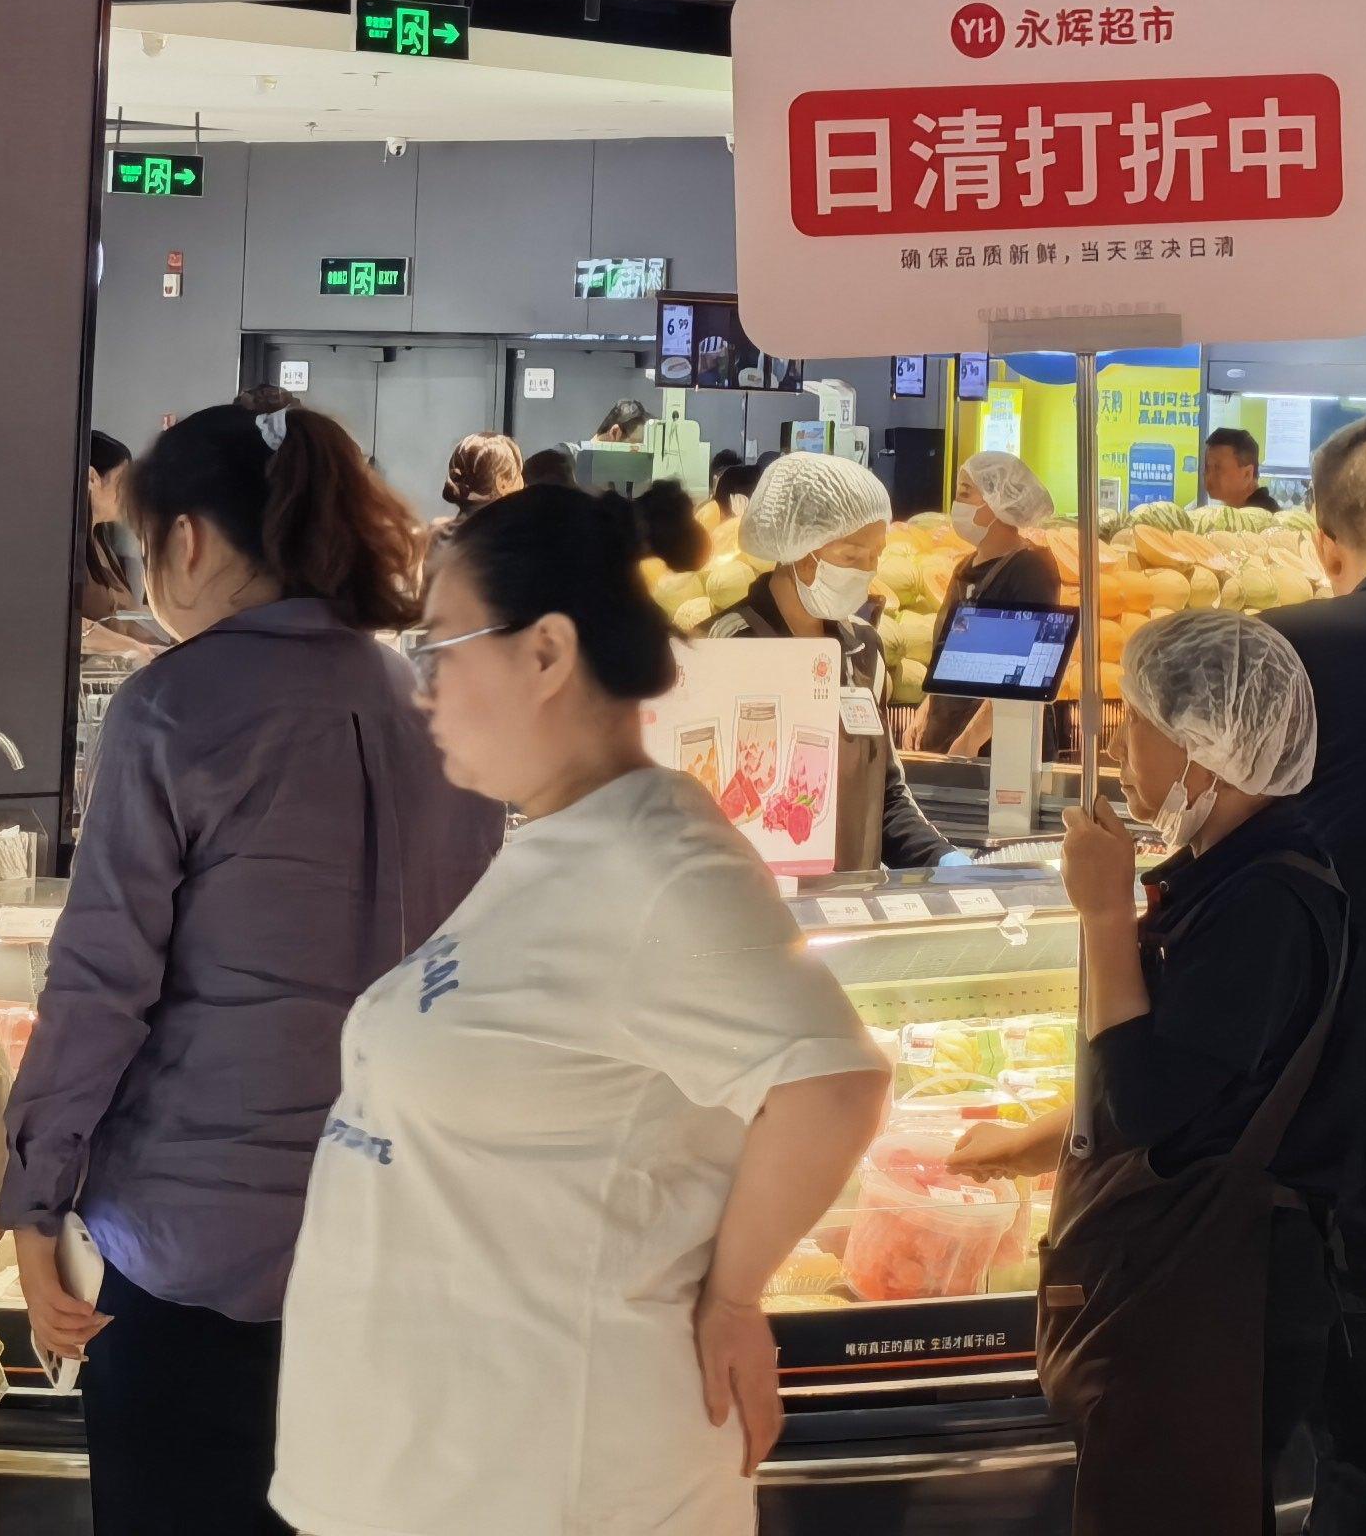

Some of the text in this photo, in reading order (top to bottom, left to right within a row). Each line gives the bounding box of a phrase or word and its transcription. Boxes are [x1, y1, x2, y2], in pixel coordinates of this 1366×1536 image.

[1014, 5, 1175, 49] 永辉超市
[813, 97, 1318, 215] 日清打折中
